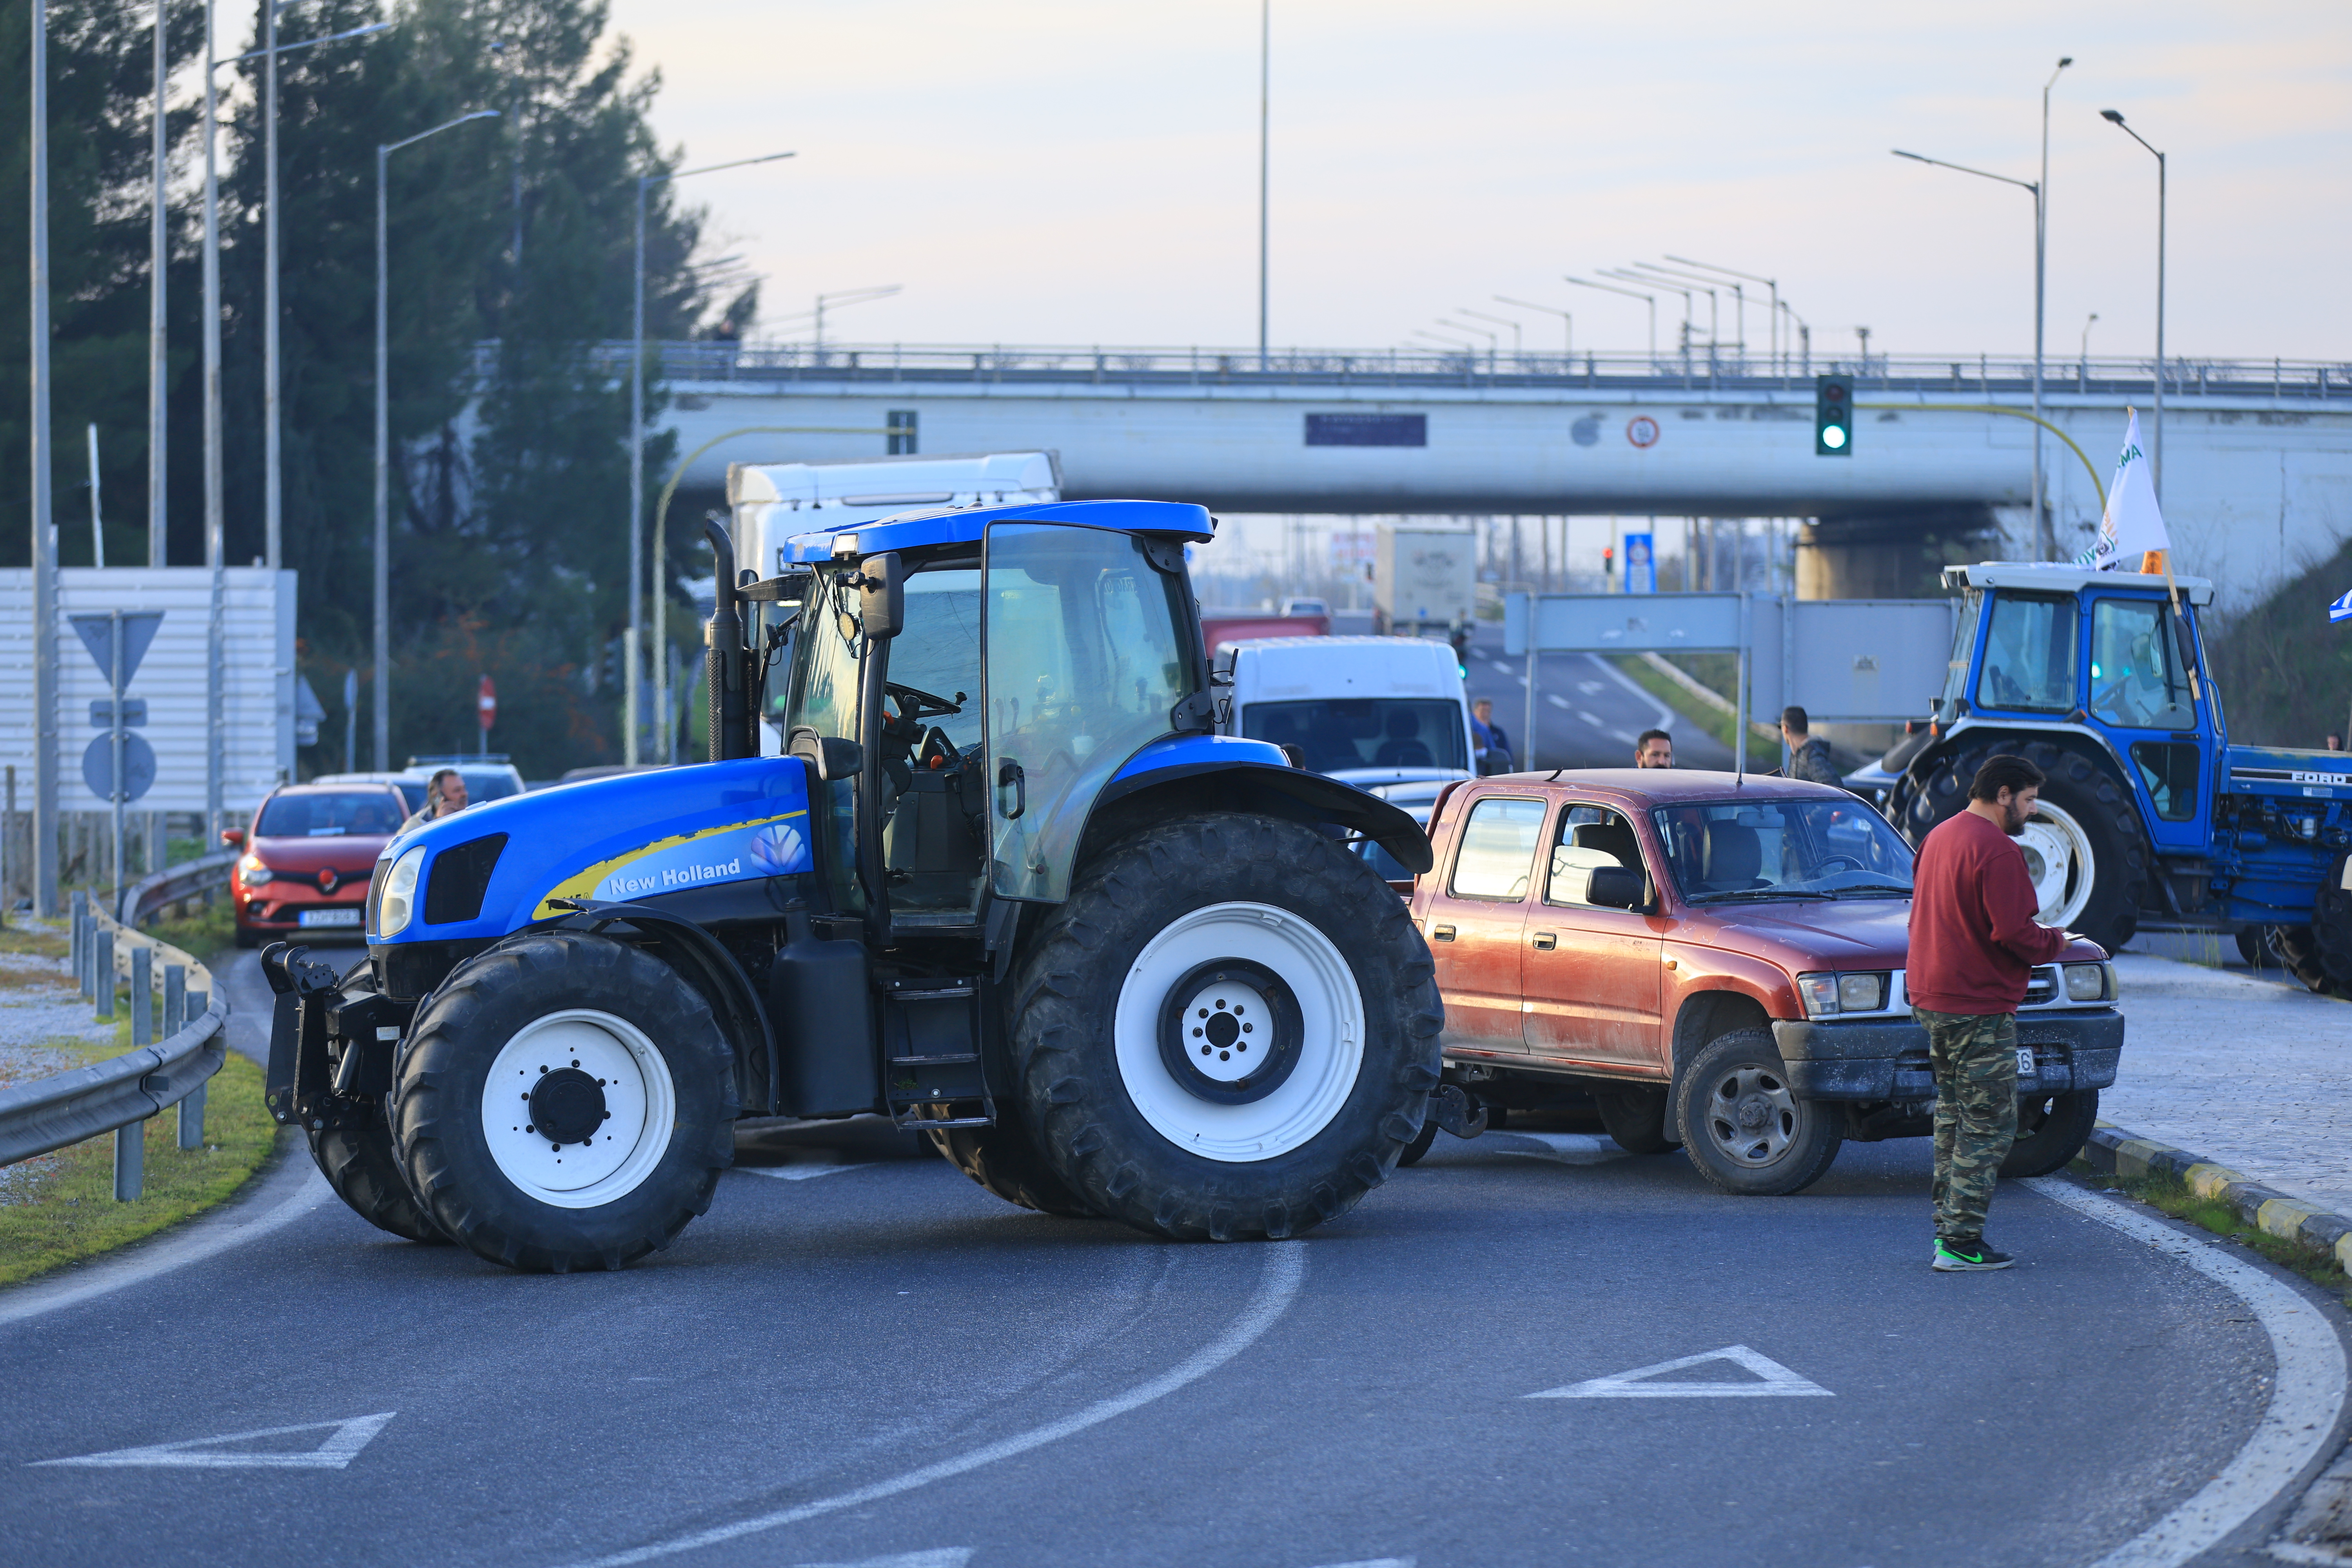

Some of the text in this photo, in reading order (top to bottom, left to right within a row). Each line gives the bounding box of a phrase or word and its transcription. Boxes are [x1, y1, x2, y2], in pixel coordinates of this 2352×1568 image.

[2292, 772, 2346, 783] FORD
[610, 858, 741, 895] New Holland
